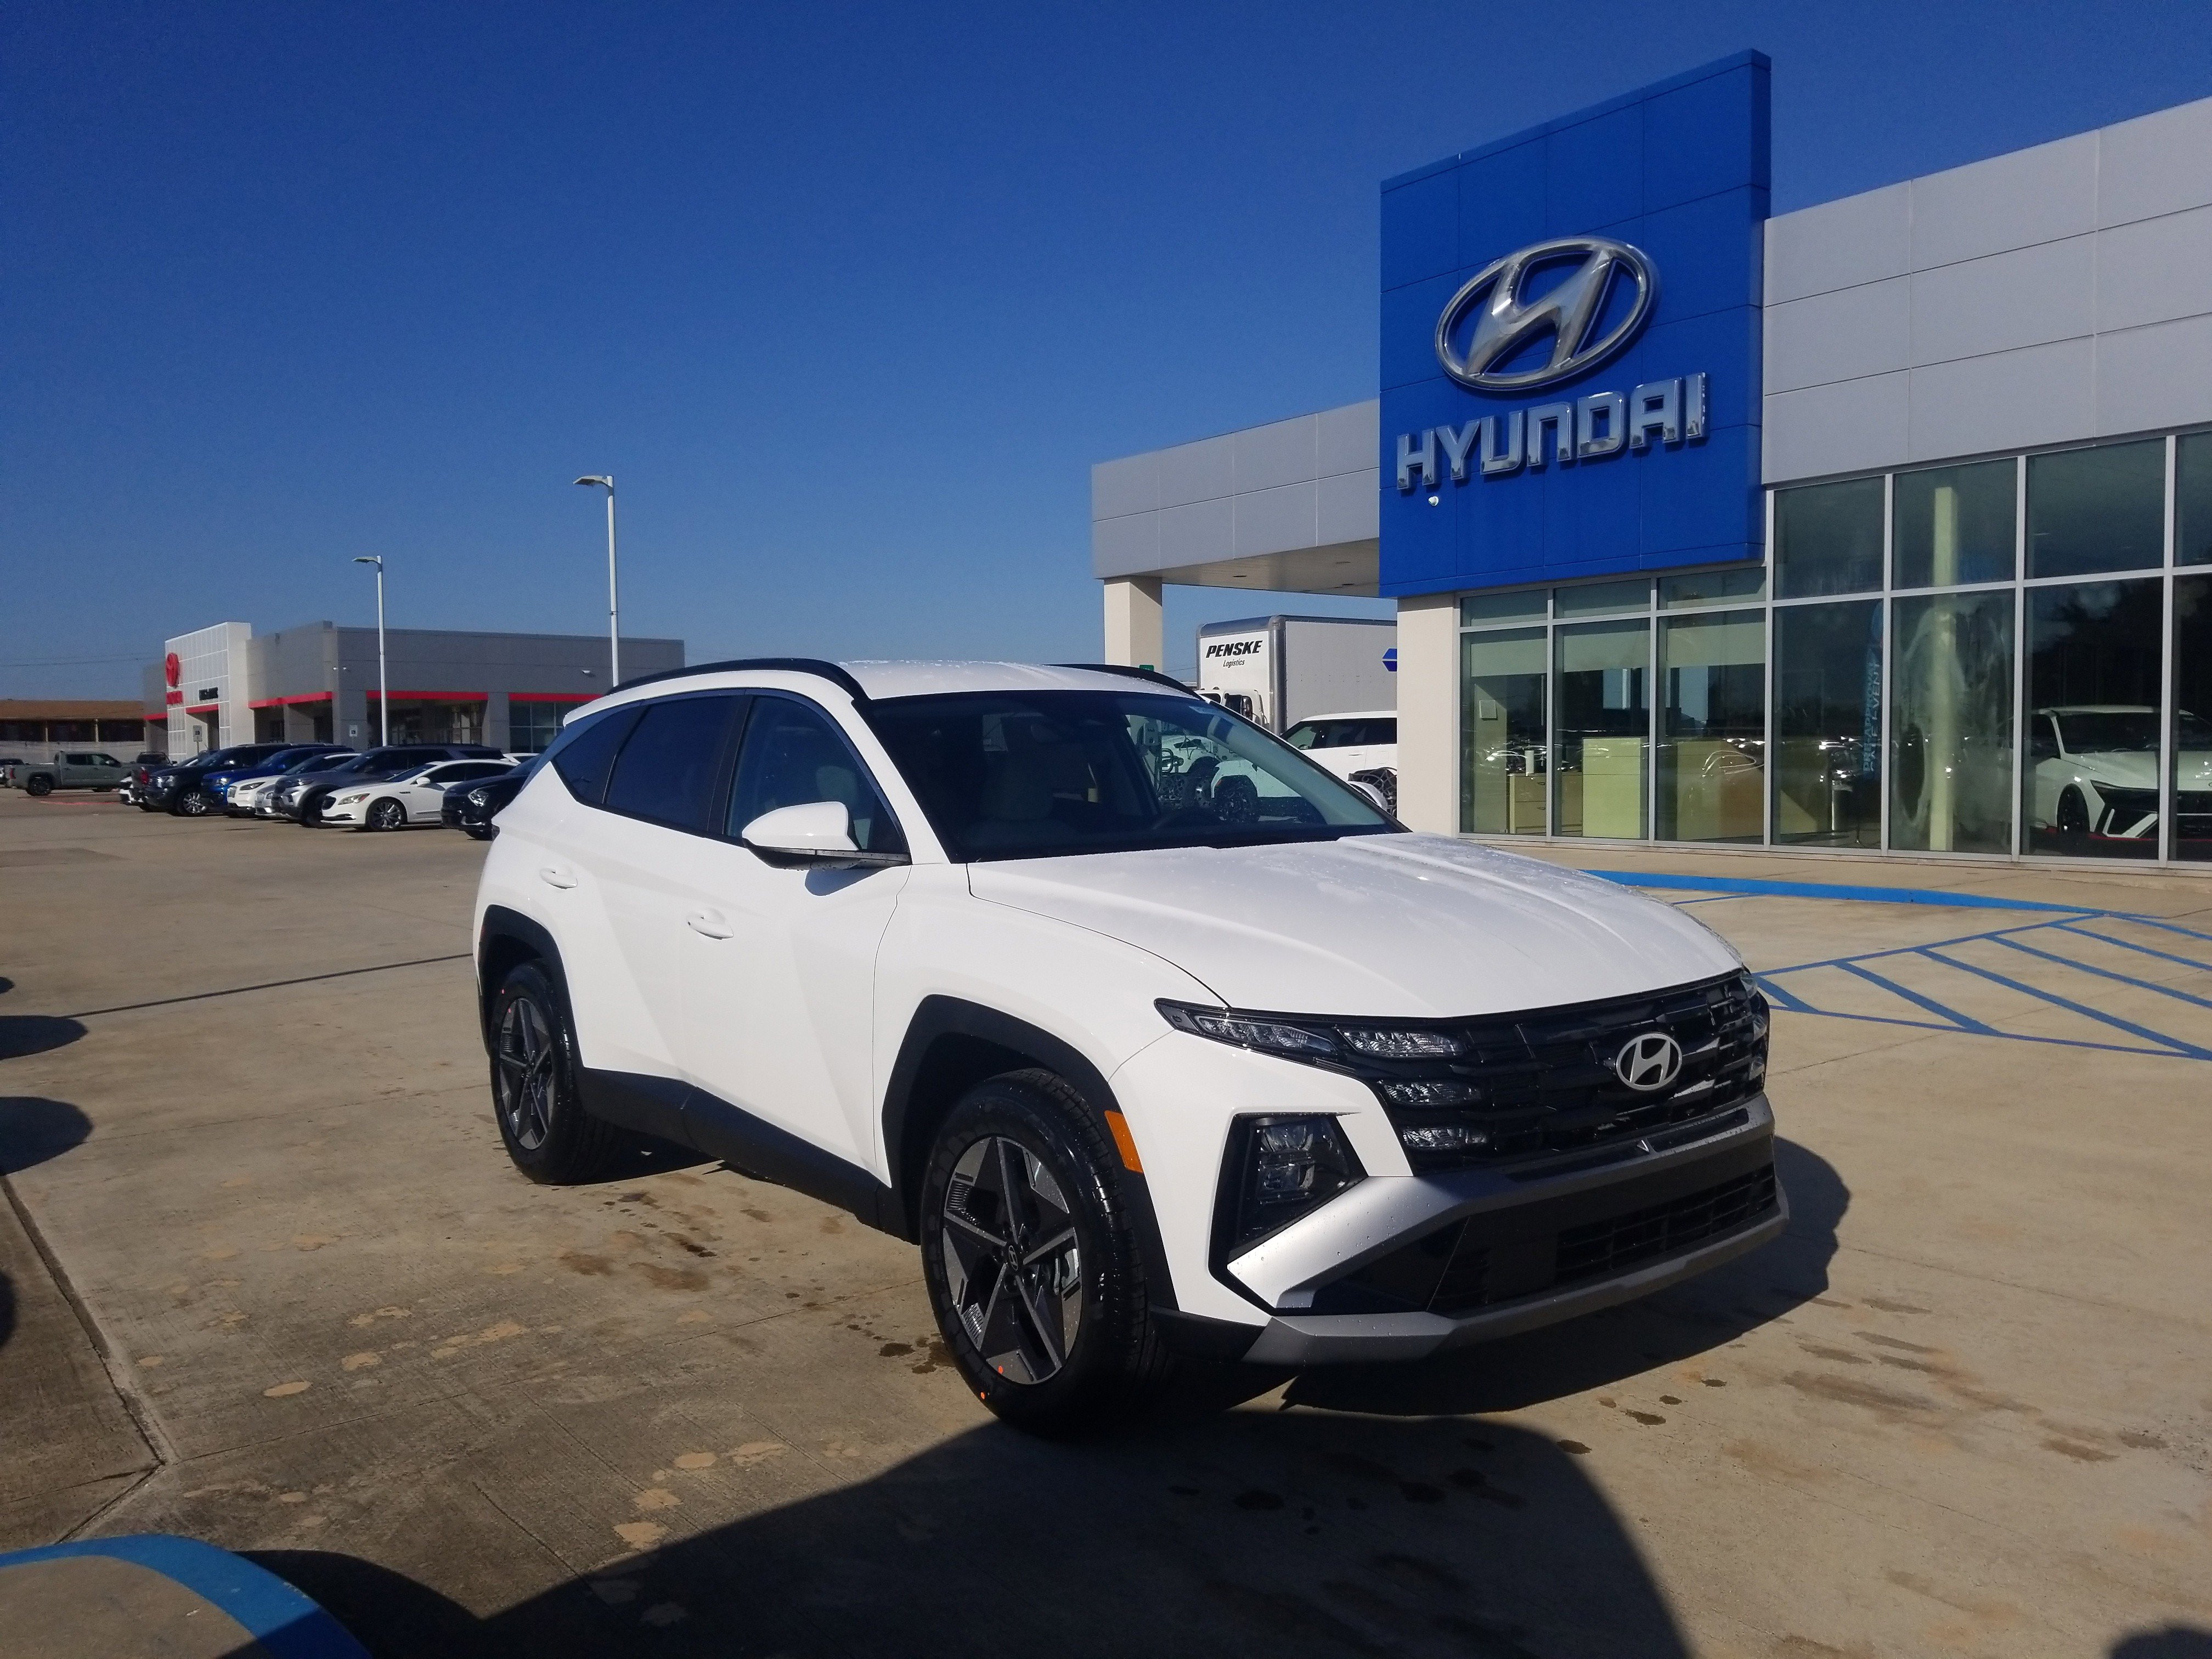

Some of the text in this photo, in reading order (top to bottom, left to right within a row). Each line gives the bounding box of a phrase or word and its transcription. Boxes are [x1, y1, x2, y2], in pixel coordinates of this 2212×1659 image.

[1397, 373, 1707, 490] HYUNDAI
[1206, 640, 1263, 658] PENSKE
[1223, 658, 1245, 668] Logistics
